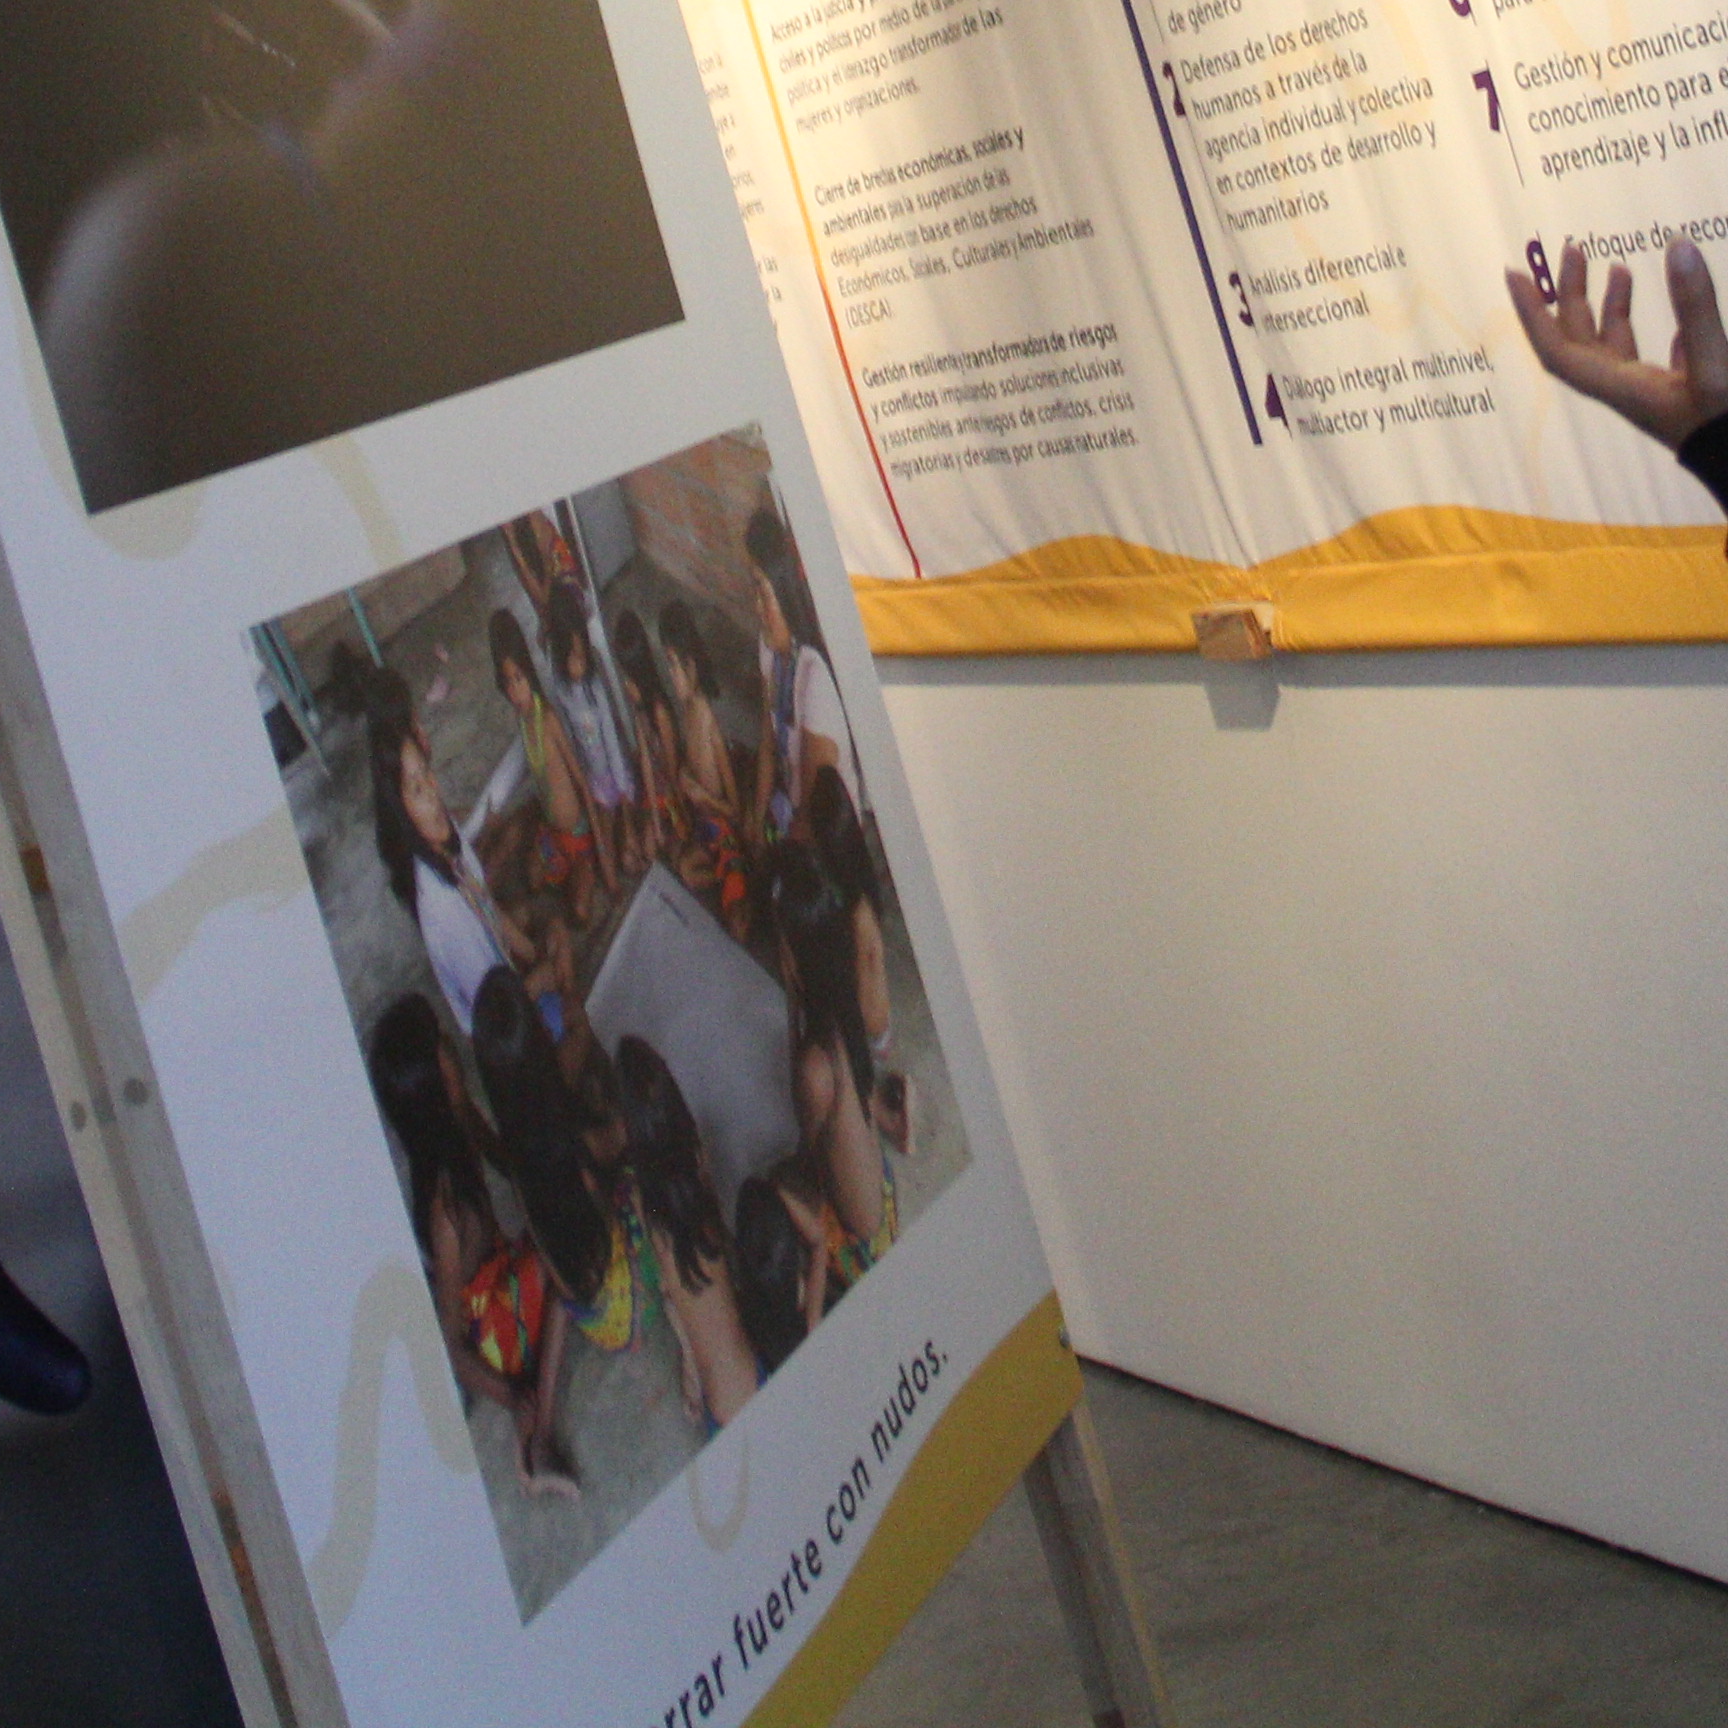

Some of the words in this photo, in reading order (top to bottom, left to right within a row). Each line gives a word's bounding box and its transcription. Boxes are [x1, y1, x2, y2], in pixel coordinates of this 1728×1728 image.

[1169, 11, 1185, 34] de
[1180, 50, 1241, 84] Defensa
[1267, 32, 1297, 56] los
[1300, 8, 1368, 47] derechos
[1163, 62, 1186, 117] 2
[1192, 85, 1262, 119] humanos
[1277, 64, 1332, 94] través
[1514, 53, 1588, 90] Gestión
[1205, 127, 1261, 163] agencia
[1263, 97, 1347, 141] individual
[1358, 78, 1433, 116] colectiva
[1472, 68, 1500, 132] 7
[1528, 84, 1661, 133] conocimiento
[1665, 73, 1713, 109] para
[1236, 152, 1317, 190] contextos
[1347, 122, 1422, 162] desarrollo
[1541, 135, 1650, 180] aprendizaje
[916, 176, 982, 210] superación
[1224, 191, 1329, 234] humanitarios
[919, 222, 951, 244] base
[1565, 231, 1646, 270] nfoque
[1247, 270, 1302, 297] Análisis
[1526, 240, 1556, 303] 8
[1229, 271, 1254, 327] 3
[1339, 358, 1409, 393] integral
[1412, 345, 1494, 379] multinivel,
[881, 390, 939, 416] conflictos
[1099, 392, 1135, 414] crisis
[1265, 373, 1289, 427] 4
[1389, 387, 1495, 423] multicultural
[733, 1539, 824, 1670] fuerte
[826, 1457, 871, 1545] con
[872, 1339, 948, 1462] nudos.
